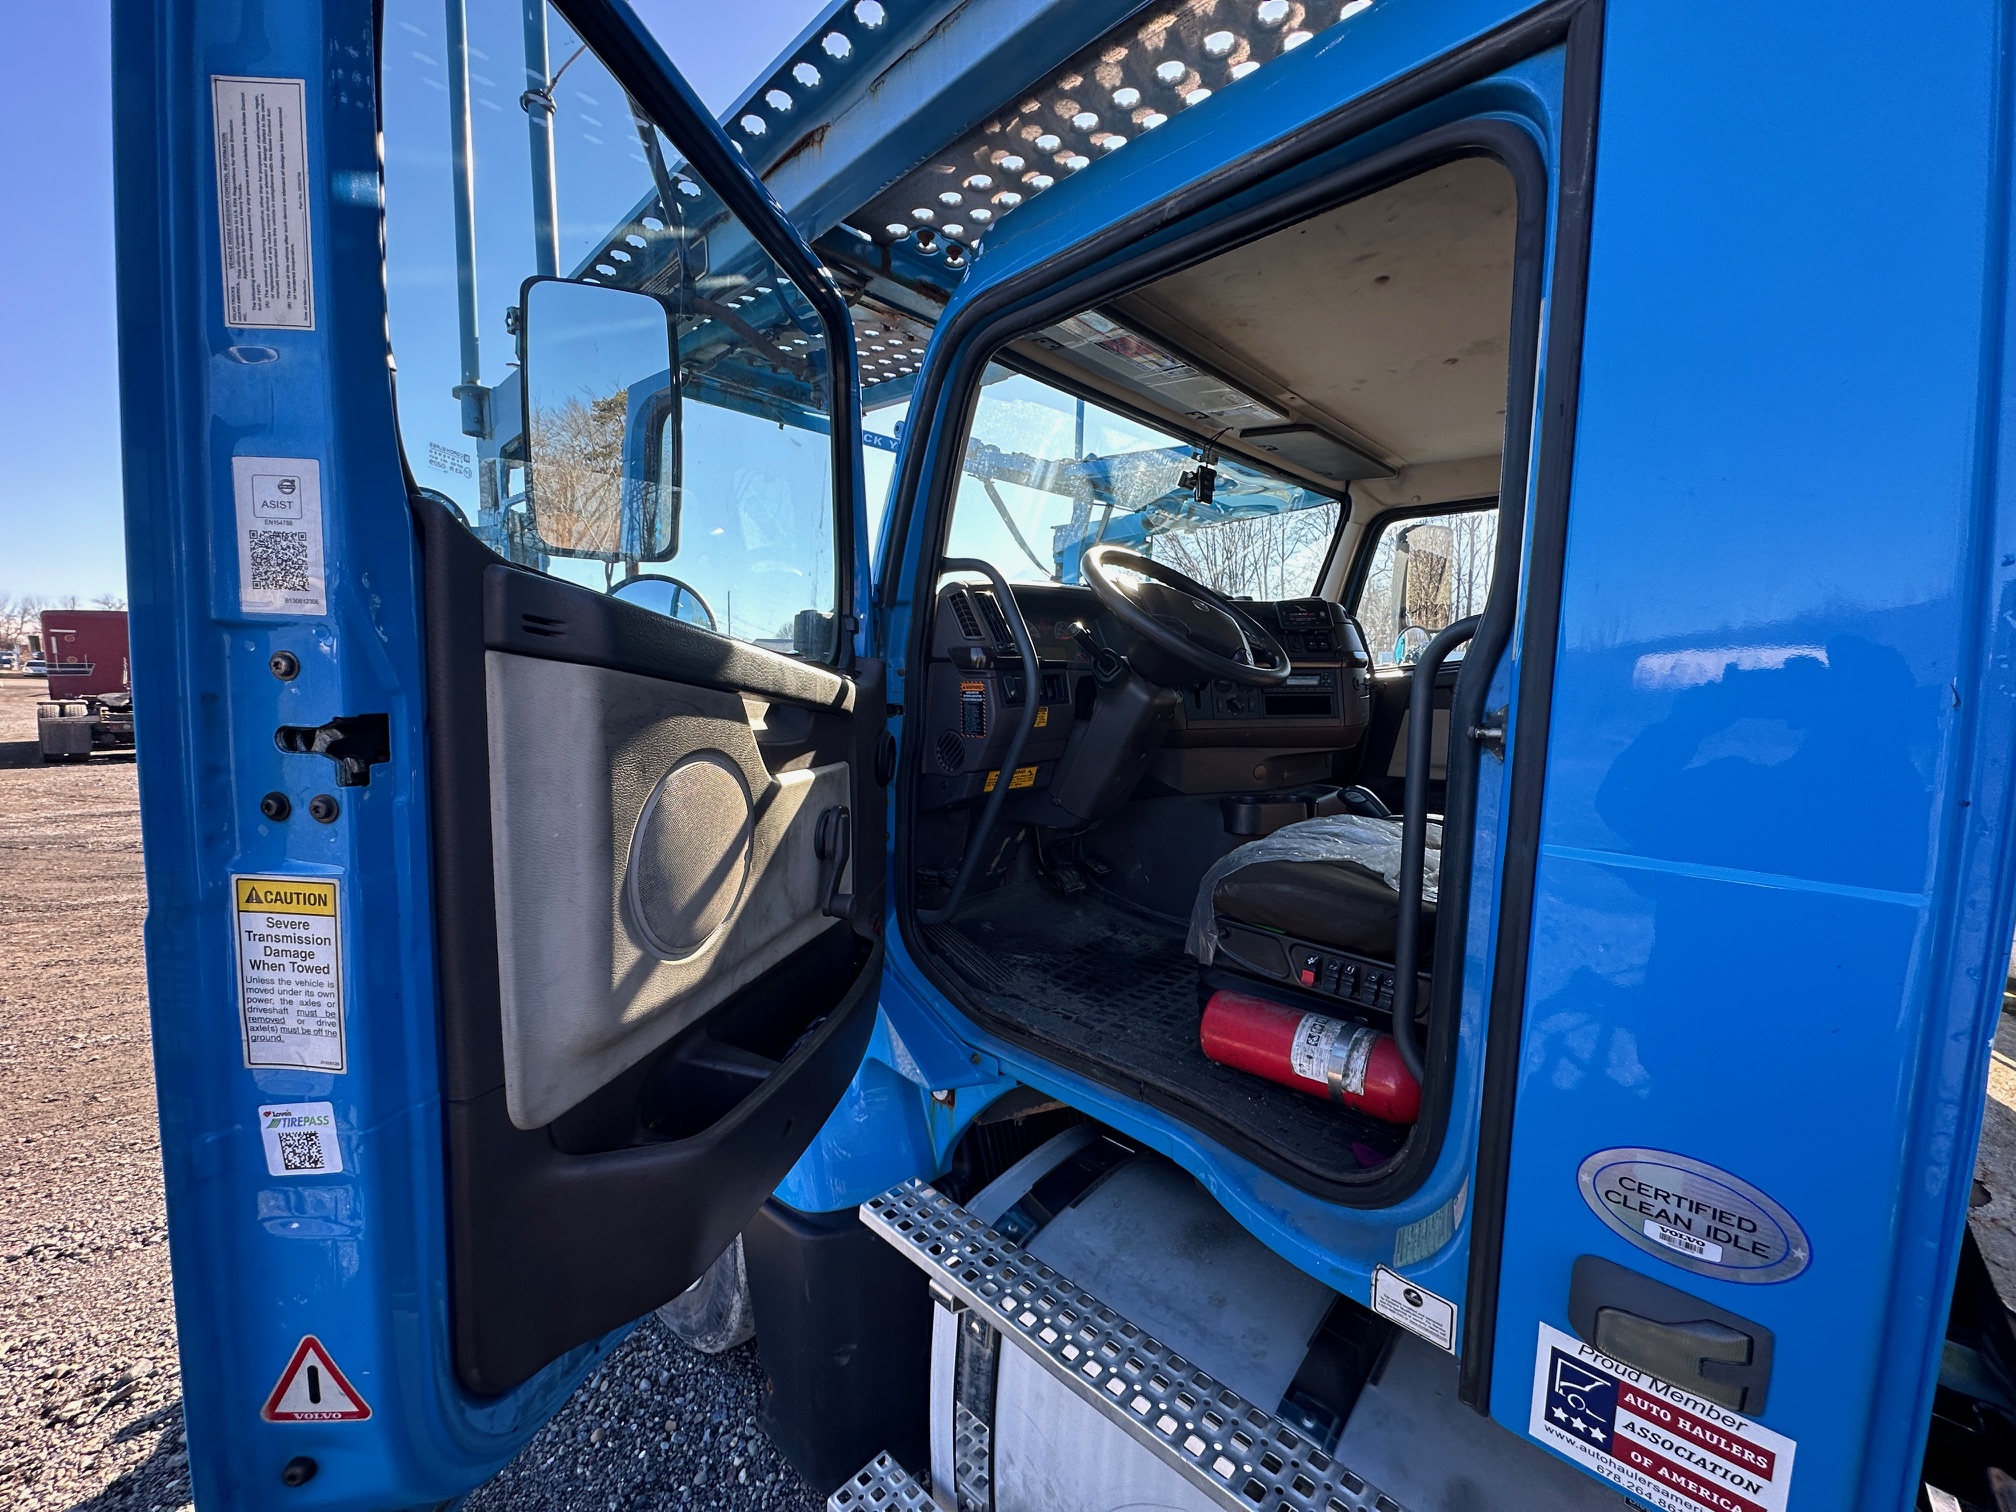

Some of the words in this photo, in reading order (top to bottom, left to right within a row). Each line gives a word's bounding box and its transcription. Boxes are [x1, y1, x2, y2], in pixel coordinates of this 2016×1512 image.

[261, 500, 293, 510] ASIST
[264, 890, 327, 906] CAUTION
[266, 917, 310, 930] Severe
[245, 930, 331, 946] Transmission
[264, 946, 315, 961] Damage
[249, 959, 285, 972] When
[289, 962, 330, 975] Towed
[246, 976, 275, 985] Unless
[295, 979, 324, 988] vehicle
[328, 980, 334, 988] is
[246, 986, 275, 994] moved
[278, 988, 302, 996] under
[247, 997, 275, 1006] power,
[280, 997, 294, 1006] the
[299, 999, 322, 1007] axles
[247, 1006, 289, 1015] driveshaft
[248, 1016, 285, 1024] removed
[316, 1018, 336, 1027] drive
[250, 1025, 278, 1034] axle(s)
[281, 1026, 299, 1034] must
[313, 1028, 323, 1036] off
[325, 1029, 337, 1037] the
[251, 1034, 284, 1043] ground.
[282, 1115, 329, 1128] TIREPASS
[1618, 1176, 1757, 1234] CERTIFIED
[1604, 1189, 1693, 1230] CLEAN
[1706, 1225, 1771, 1259] IDLE
[1659, 1225, 1705, 1246] VOLVO
[1578, 1344, 1642, 1382] Proud
[1648, 1376, 1749, 1432] Member
[1624, 1392, 1671, 1422] AUTO
[1677, 1416, 1768, 1470] HAULERS
[1622, 1420, 1763, 1495] ASSOCIATION
[1596, 1464, 1683, 1512] 678.264.86
[1630, 1451, 1653, 1468] OF
[1658, 1466, 1744, 1512] AMERICA
